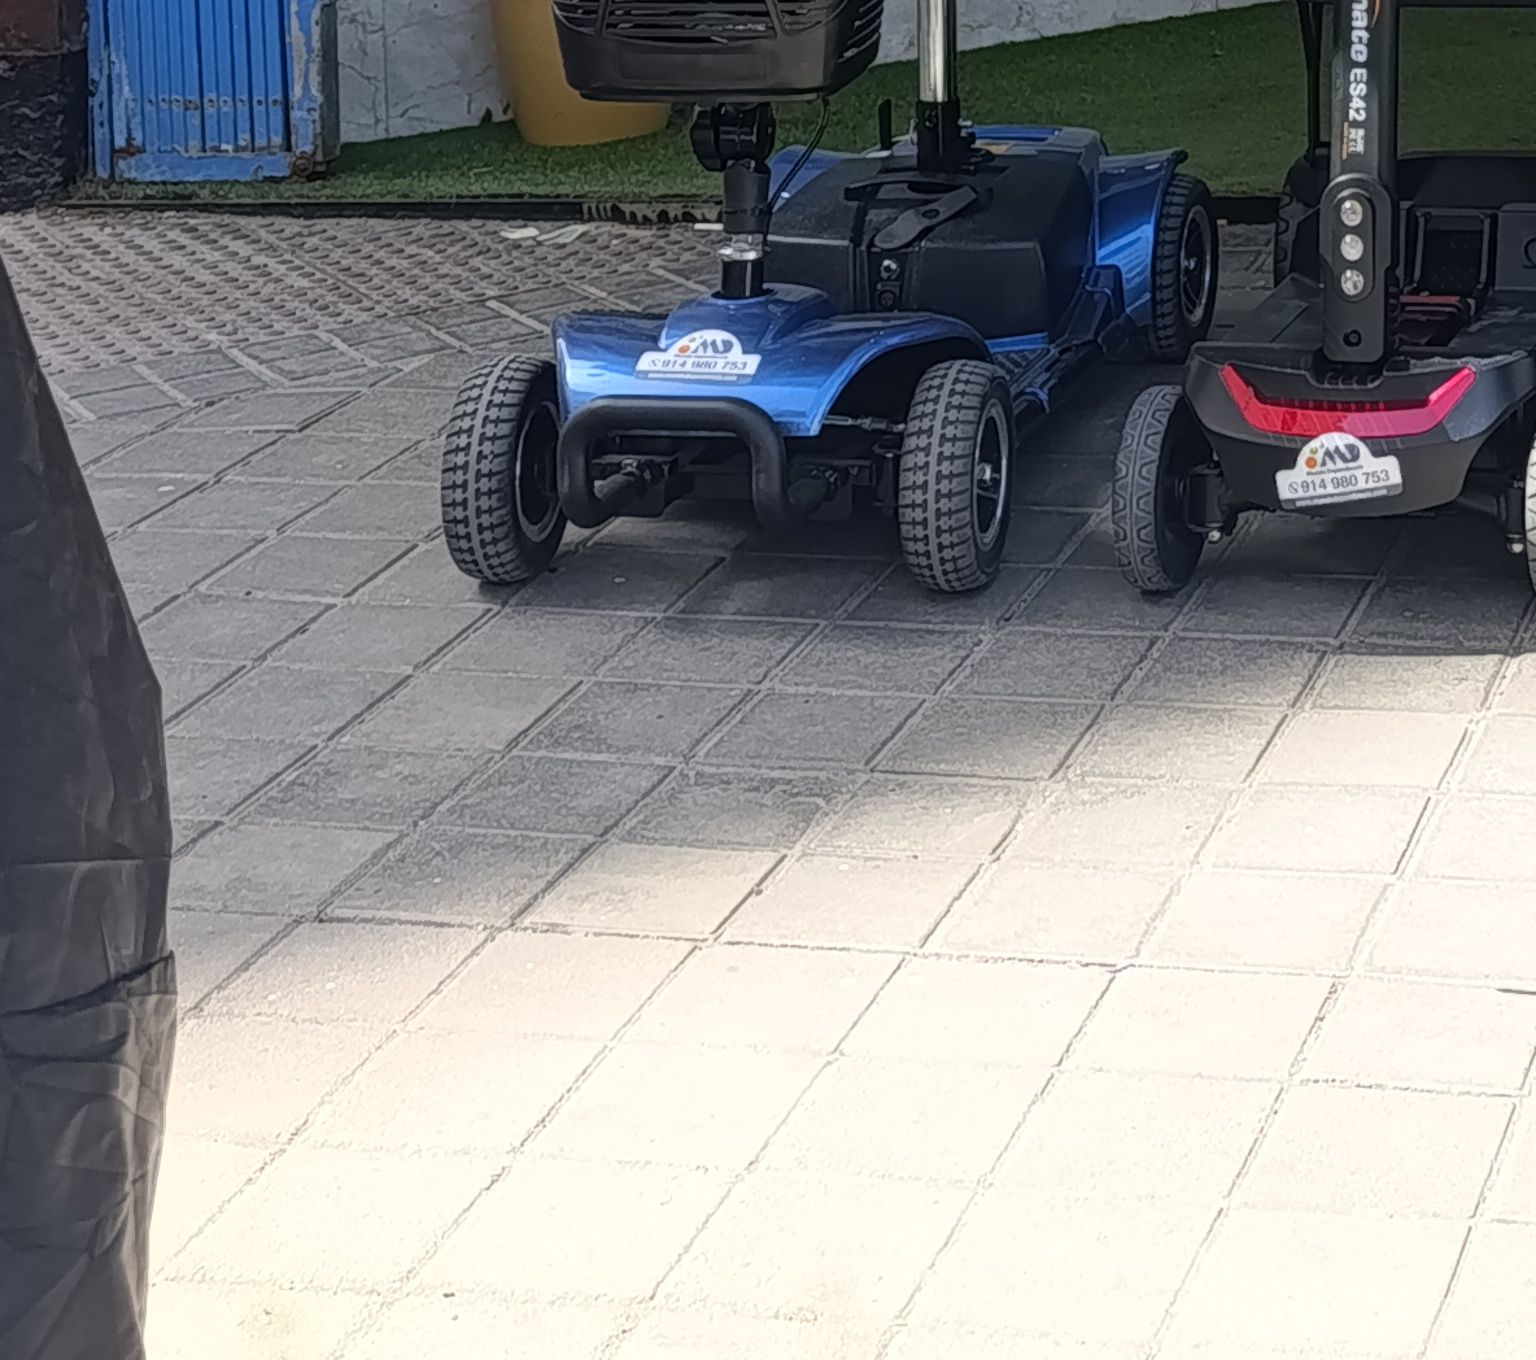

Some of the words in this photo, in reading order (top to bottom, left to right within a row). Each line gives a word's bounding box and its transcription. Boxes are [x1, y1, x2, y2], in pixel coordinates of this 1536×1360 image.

[1348, 67, 1368, 122] ES42
[661, 359, 687, 369] 914
[721, 360, 748, 371] 753
[1301, 479, 1327, 494] 914
[1331, 474, 1359, 489] 980
[1361, 469, 1390, 485] 753
